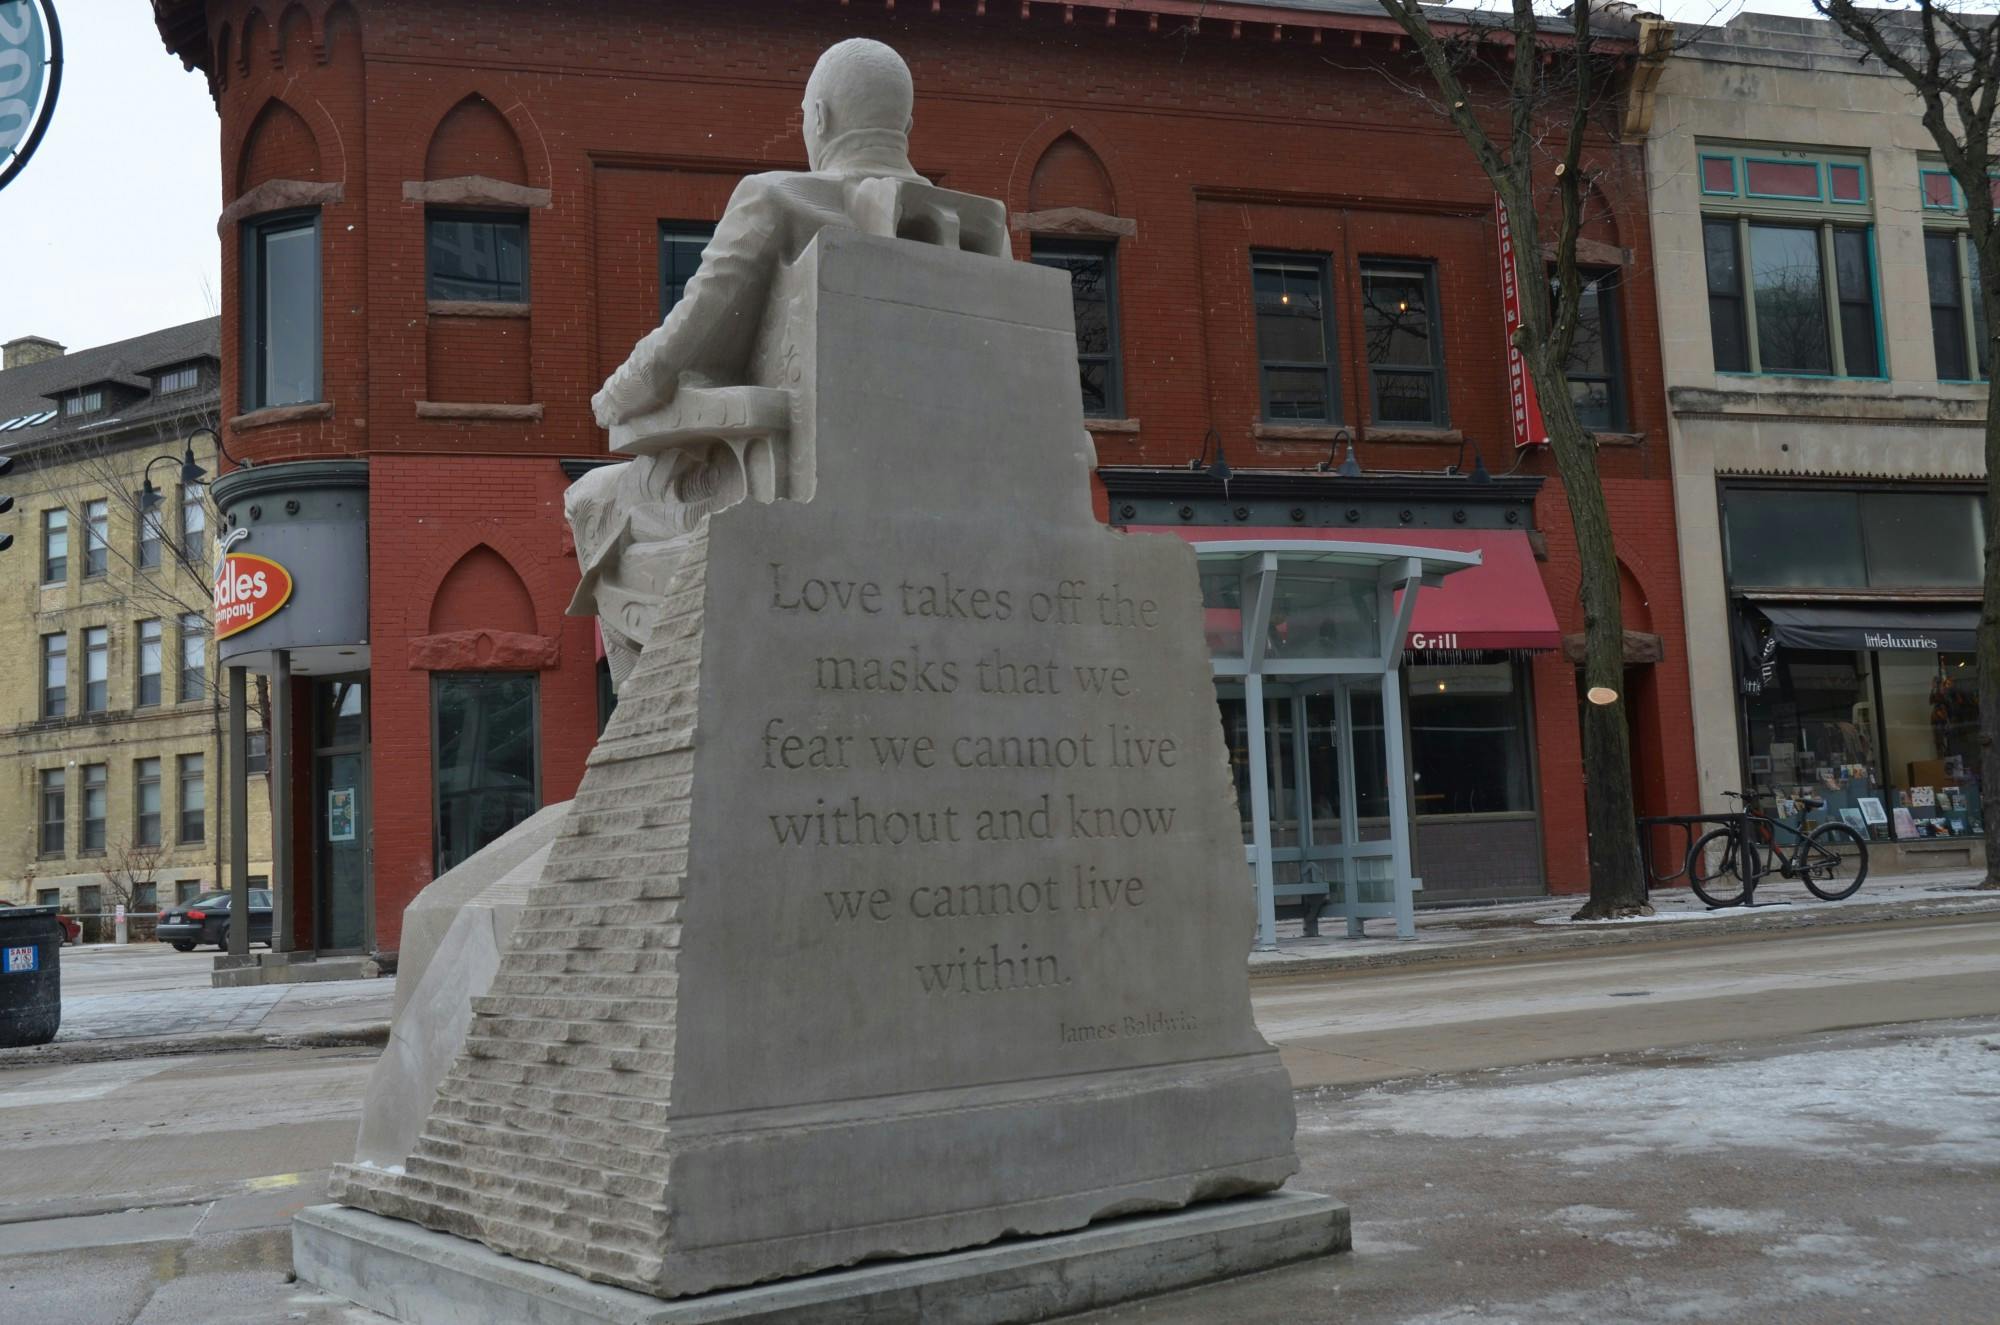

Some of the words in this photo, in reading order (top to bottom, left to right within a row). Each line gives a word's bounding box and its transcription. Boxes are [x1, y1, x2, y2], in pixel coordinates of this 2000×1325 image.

[1510, 335, 1525, 436] OMPANY
[769, 562, 882, 615] Love
[901, 572, 1013, 622] takes
[1028, 579, 1087, 625] off
[1096, 583, 1160, 629] the
[1412, 633, 1457, 649] Grill
[815, 644, 960, 694] masks
[975, 649, 1060, 696] that
[1073, 665, 1132, 697] we
[761, 718, 854, 770] fear
[870, 733, 936, 768] we
[952, 730, 1097, 769] cannot
[1108, 723, 1177, 768] live
[769, 796, 959, 847] without
[975, 794, 1055, 843] and
[1067, 793, 1177, 840] know
[824, 886, 893, 923] we
[909, 874, 1061, 920] cannot
[1073, 864, 1145, 911] live
[914, 942, 1073, 995] within.
[1058, 1022, 1118, 1049] James
[1122, 1010, 1199, 1037] Baldwin
